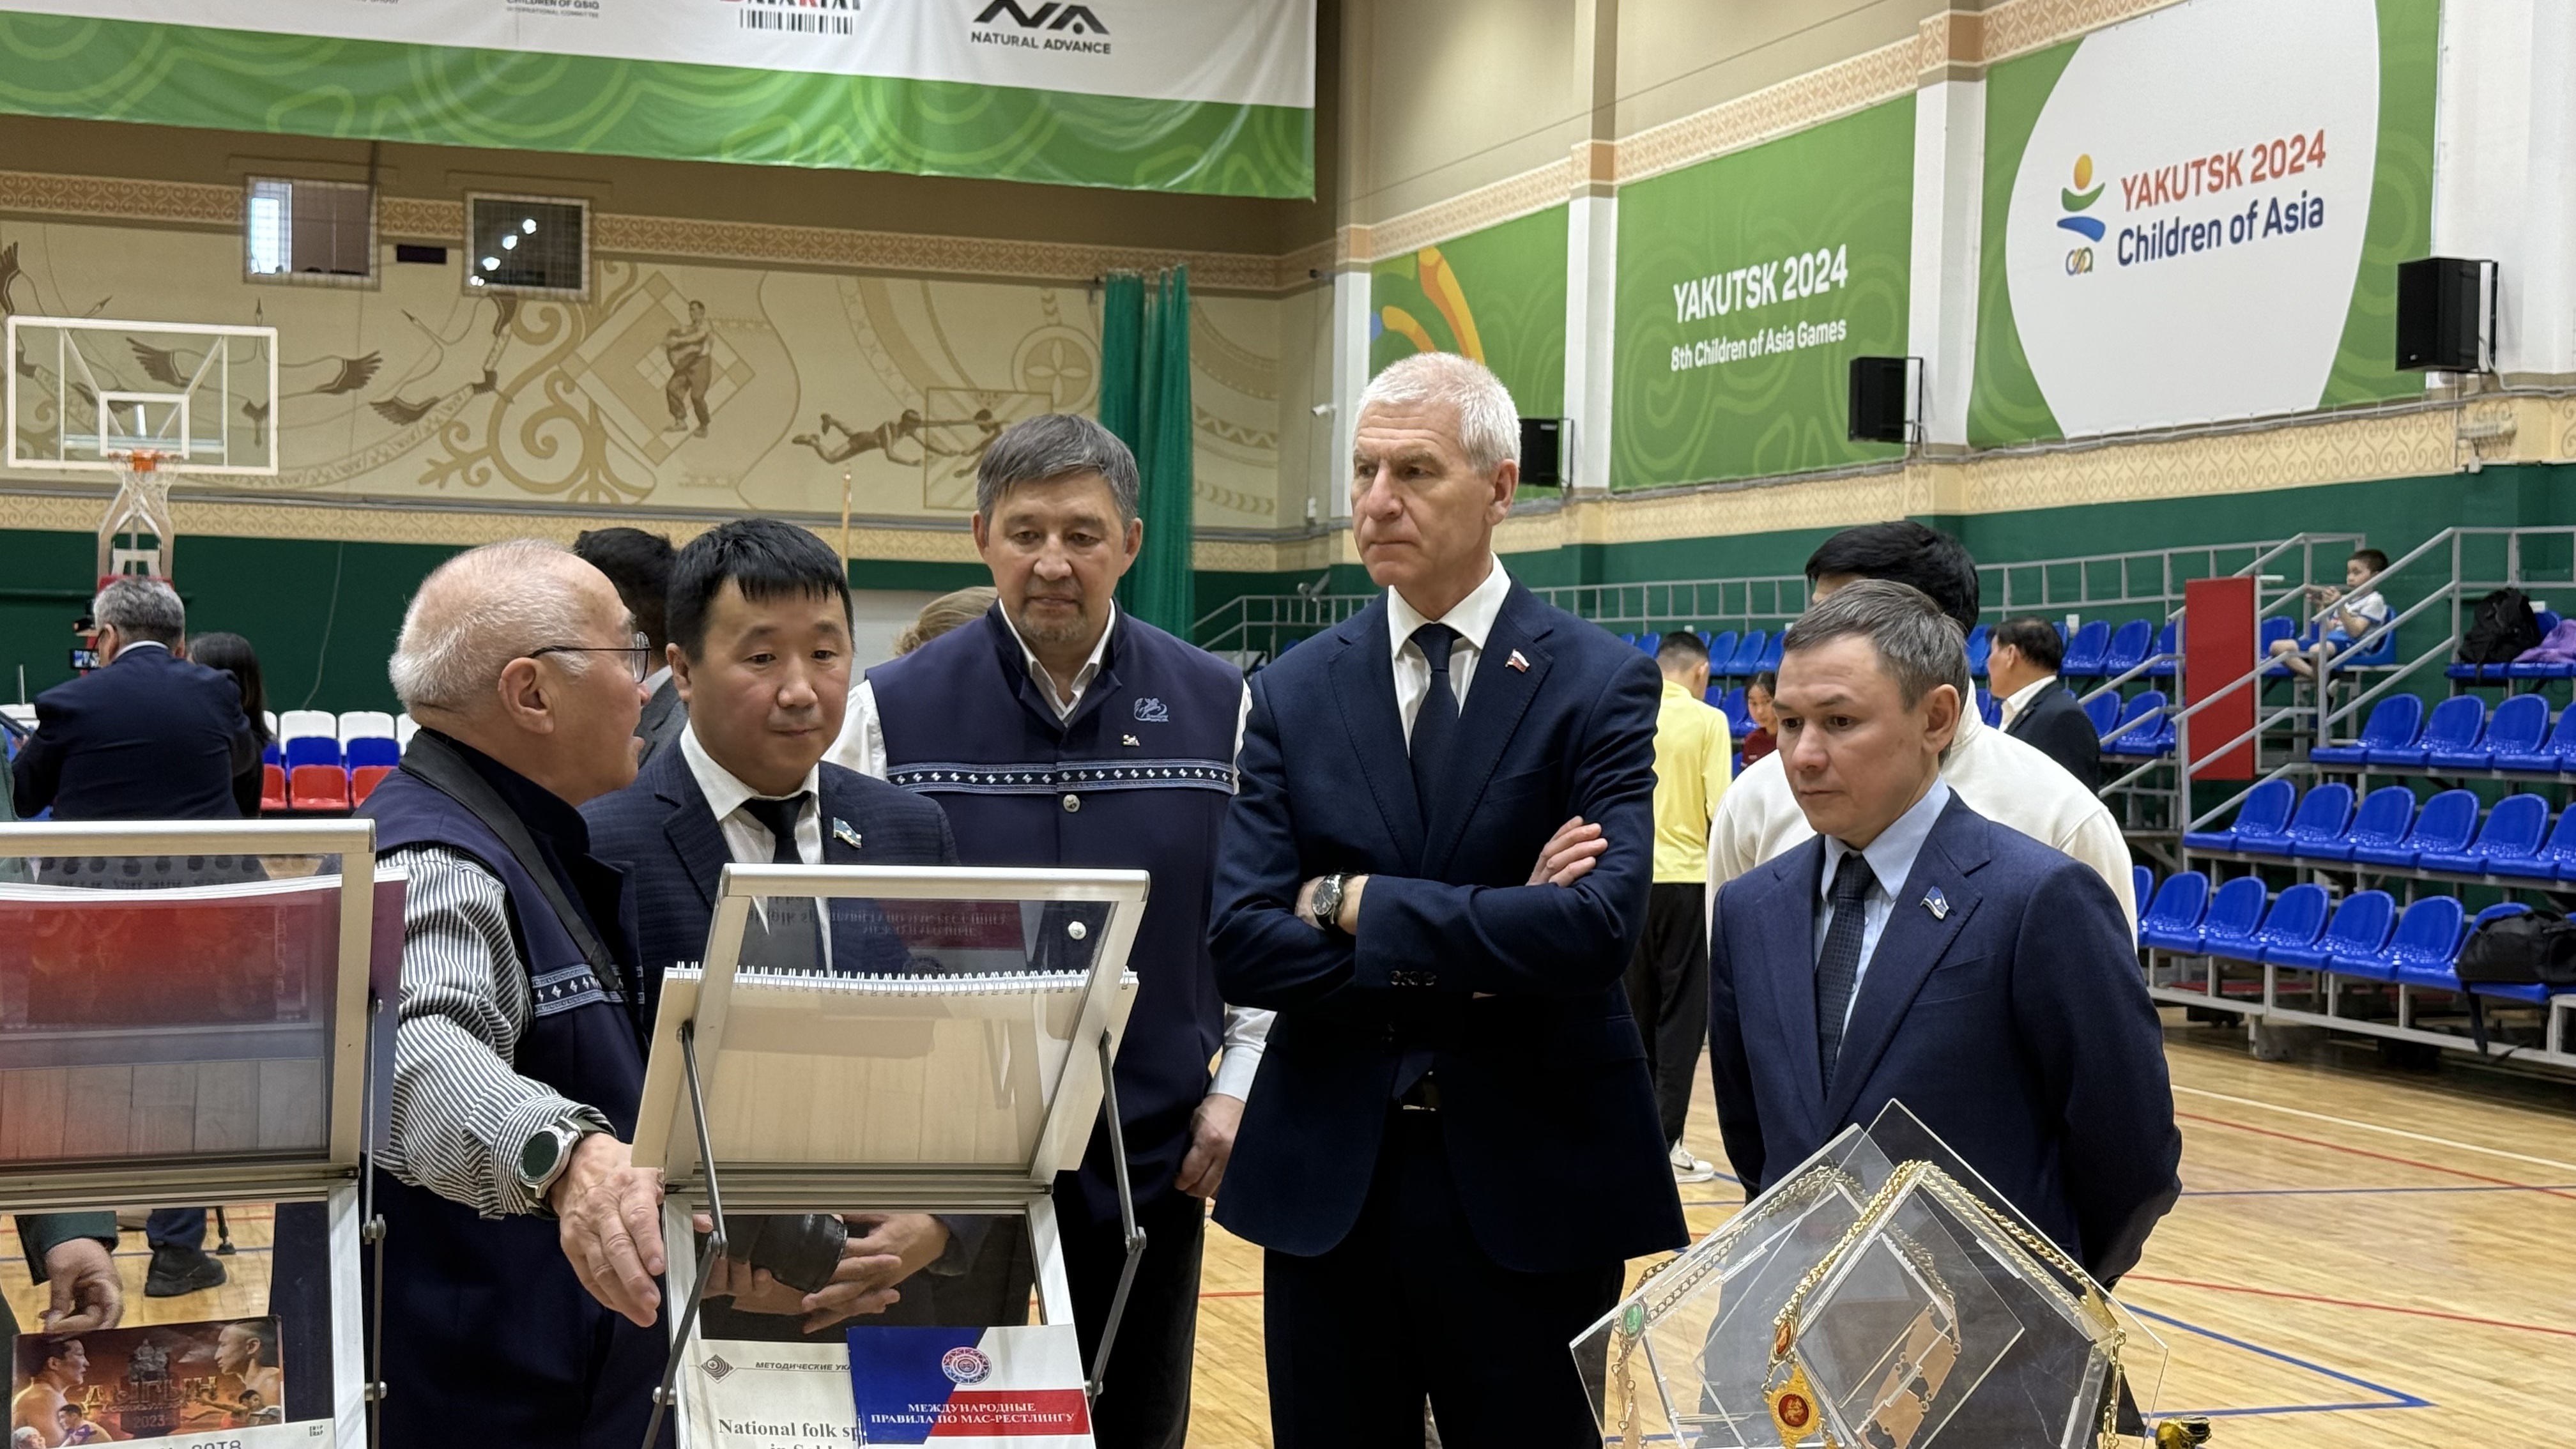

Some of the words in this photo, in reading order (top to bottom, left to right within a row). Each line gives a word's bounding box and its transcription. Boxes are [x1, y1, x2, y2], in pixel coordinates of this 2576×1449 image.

[971, 31, 1039, 49] NATURAL
[1043, 38, 1111, 54] ADVANCE
[2120, 148, 2244, 212] YAKUTSK
[2250, 128, 2326, 184] 2024
[2118, 215, 2222, 266] Children
[2229, 199, 2258, 245] of
[2262, 189, 2324, 239] Asia
[1673, 261, 1779, 323] YAKUTSK
[1782, 243, 1848, 302] 2024
[1671, 343, 1692, 372] 8th
[1694, 329, 1747, 367] Children
[1749, 328, 1765, 358] of
[1765, 324, 1795, 355] Asia
[1797, 319, 1847, 348] Games
[755, 1361, 832, 1370] МЕТОДИЧЕСКИЕ
[871, 1414, 934, 1424] ПРАВИЛА
[937, 1414, 958, 1423] ПО
[960, 1413, 1075, 1423] МАС-РЕСТЛИНГУ
[908, 1403, 1036, 1413] МЕЖДУНАРОДНЫЕ
[133, 1414, 166, 1429] 2023
[719, 1418, 796, 1437] National
[802, 1423, 838, 1438] folk
